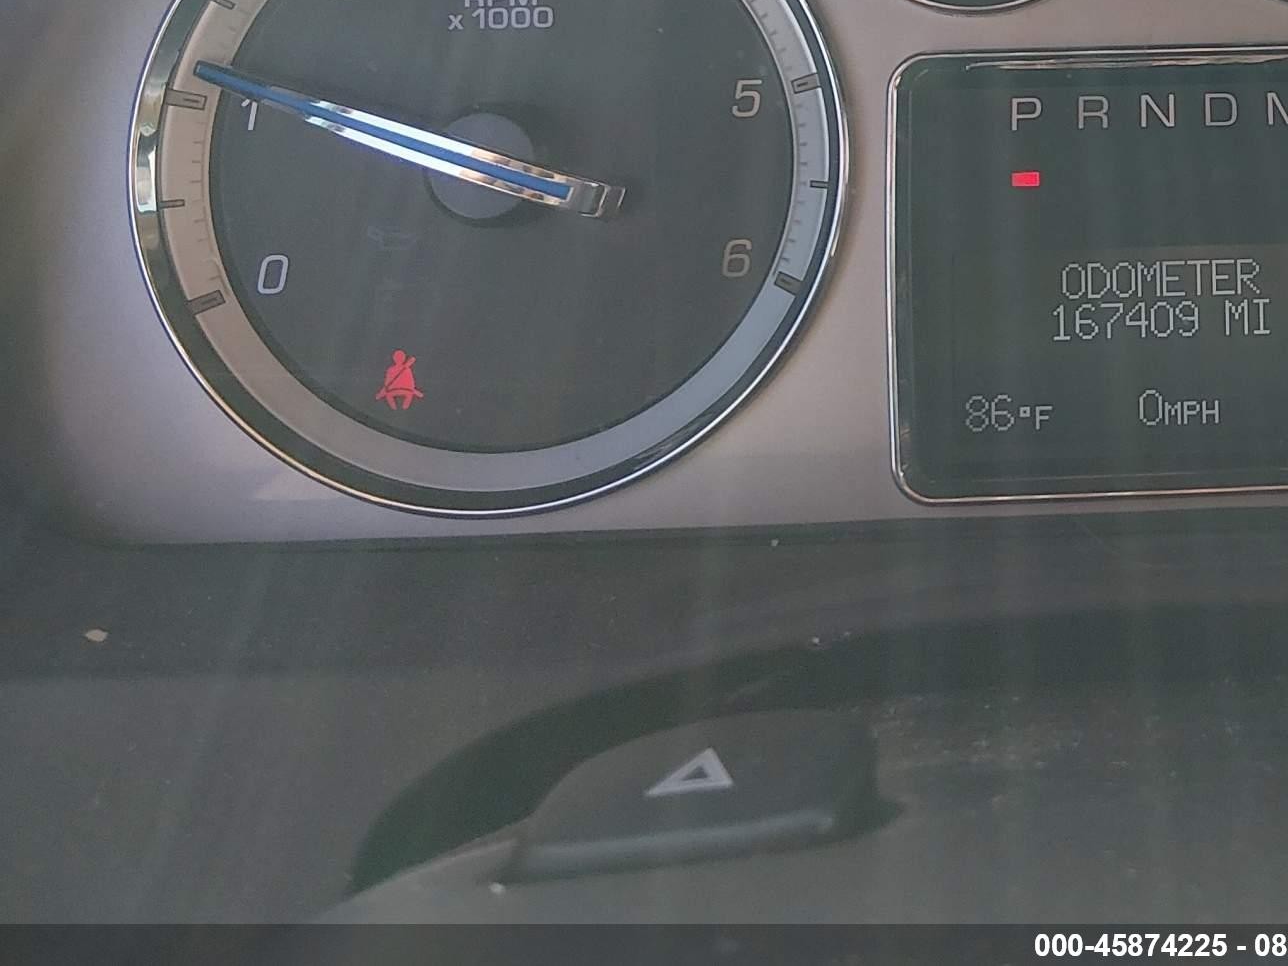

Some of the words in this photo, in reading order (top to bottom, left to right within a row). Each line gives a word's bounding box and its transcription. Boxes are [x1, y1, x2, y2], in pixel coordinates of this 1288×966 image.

[240, 98, 258, 131] 1
[732, 80, 762, 118] 5
[1011, 97, 1042, 131] P
[1078, 95, 1109, 129] R
[1140, 94, 1176, 128] N
[1204, 92, 1238, 126] D
[258, 255, 288, 294] 0
[722, 239, 751, 277] 6
[1060, 258, 1262, 300] ODOMETER
[1052, 299, 1200, 342] 167409
[1224, 298, 1271, 337] MI
